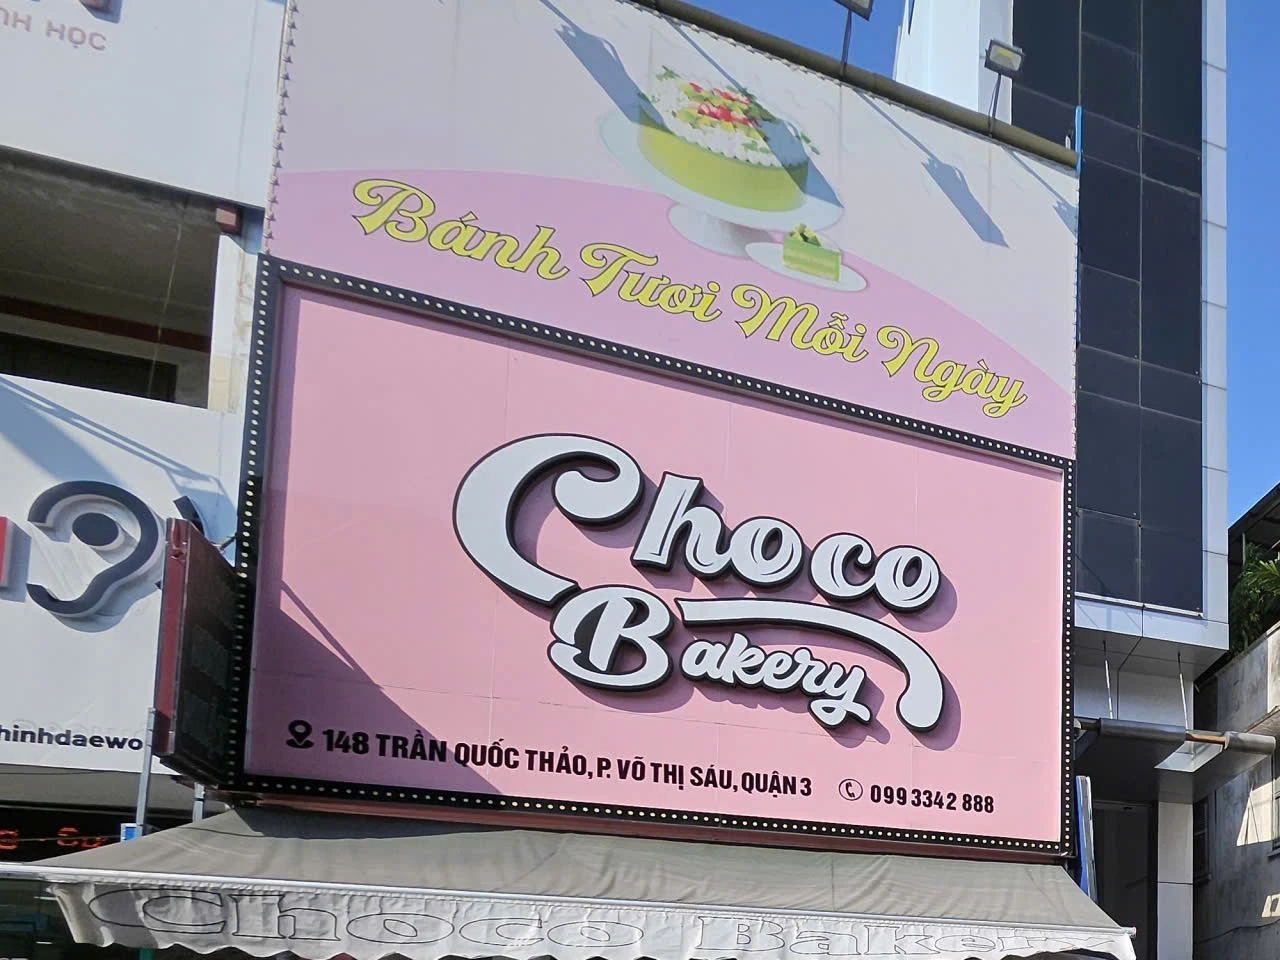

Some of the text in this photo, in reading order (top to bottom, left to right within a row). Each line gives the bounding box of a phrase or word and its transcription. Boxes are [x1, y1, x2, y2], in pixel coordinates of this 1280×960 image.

[46, 20, 107, 51] HỌC
[352, 177, 1029, 419] Bánh Tươi Mỗi Ngày
[453, 432, 942, 613] Choco
[547, 584, 874, 731] Bakery
[321, 727, 812, 799] 148 TRẦN QUỐC THẢO, P. VÕ THỊ SÁU, QUẬN 3
[870, 783, 995, 814] 099 3342 888
[89, 888, 644, 948] Choco
